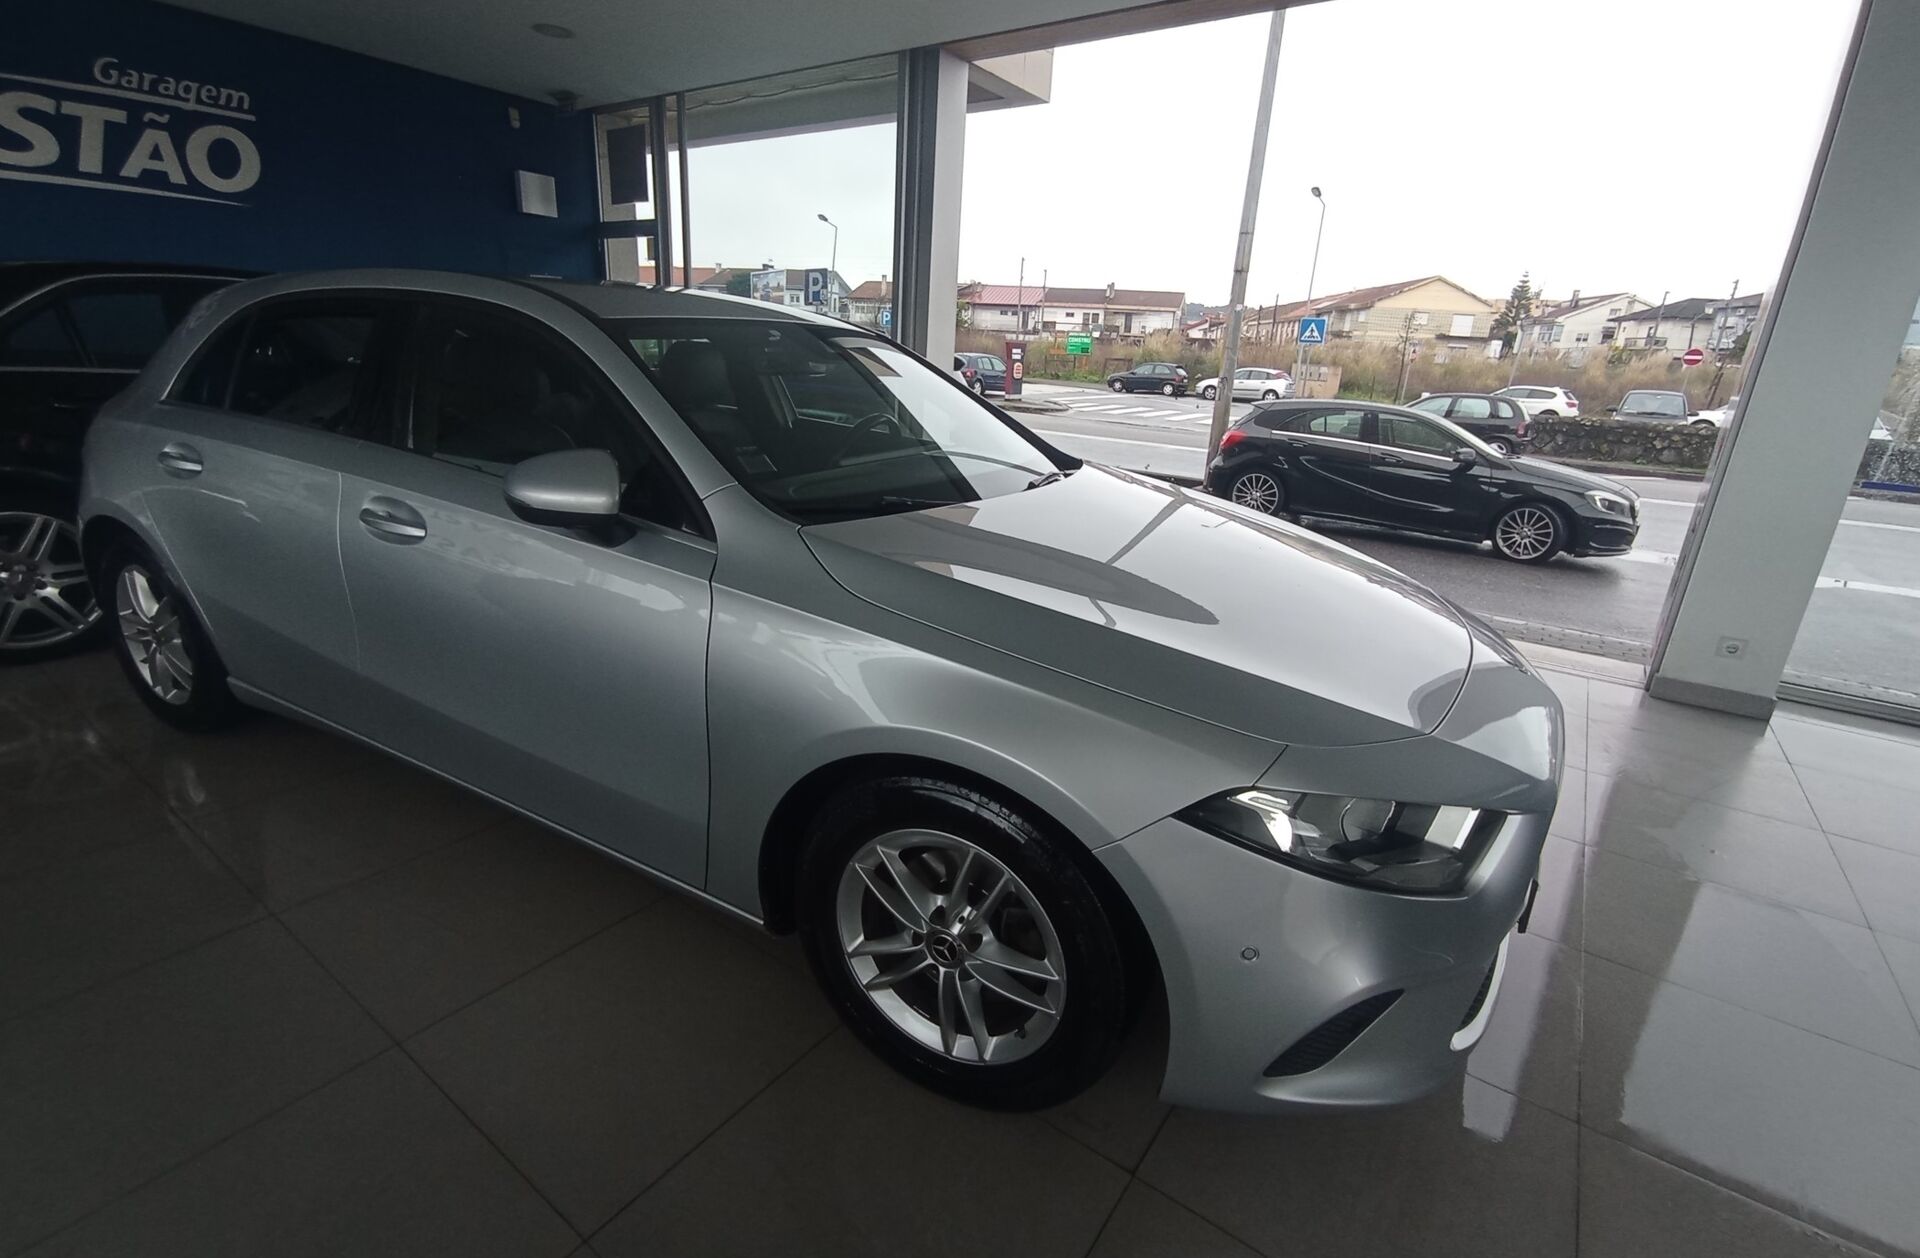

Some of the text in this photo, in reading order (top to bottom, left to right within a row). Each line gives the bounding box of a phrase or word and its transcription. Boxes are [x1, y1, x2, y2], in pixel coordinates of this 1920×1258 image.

[93, 57, 251, 110] Garagem
[0, 91, 262, 193] STÃO
[808, 271, 823, 302] P
[883, 311, 891, 325] P
